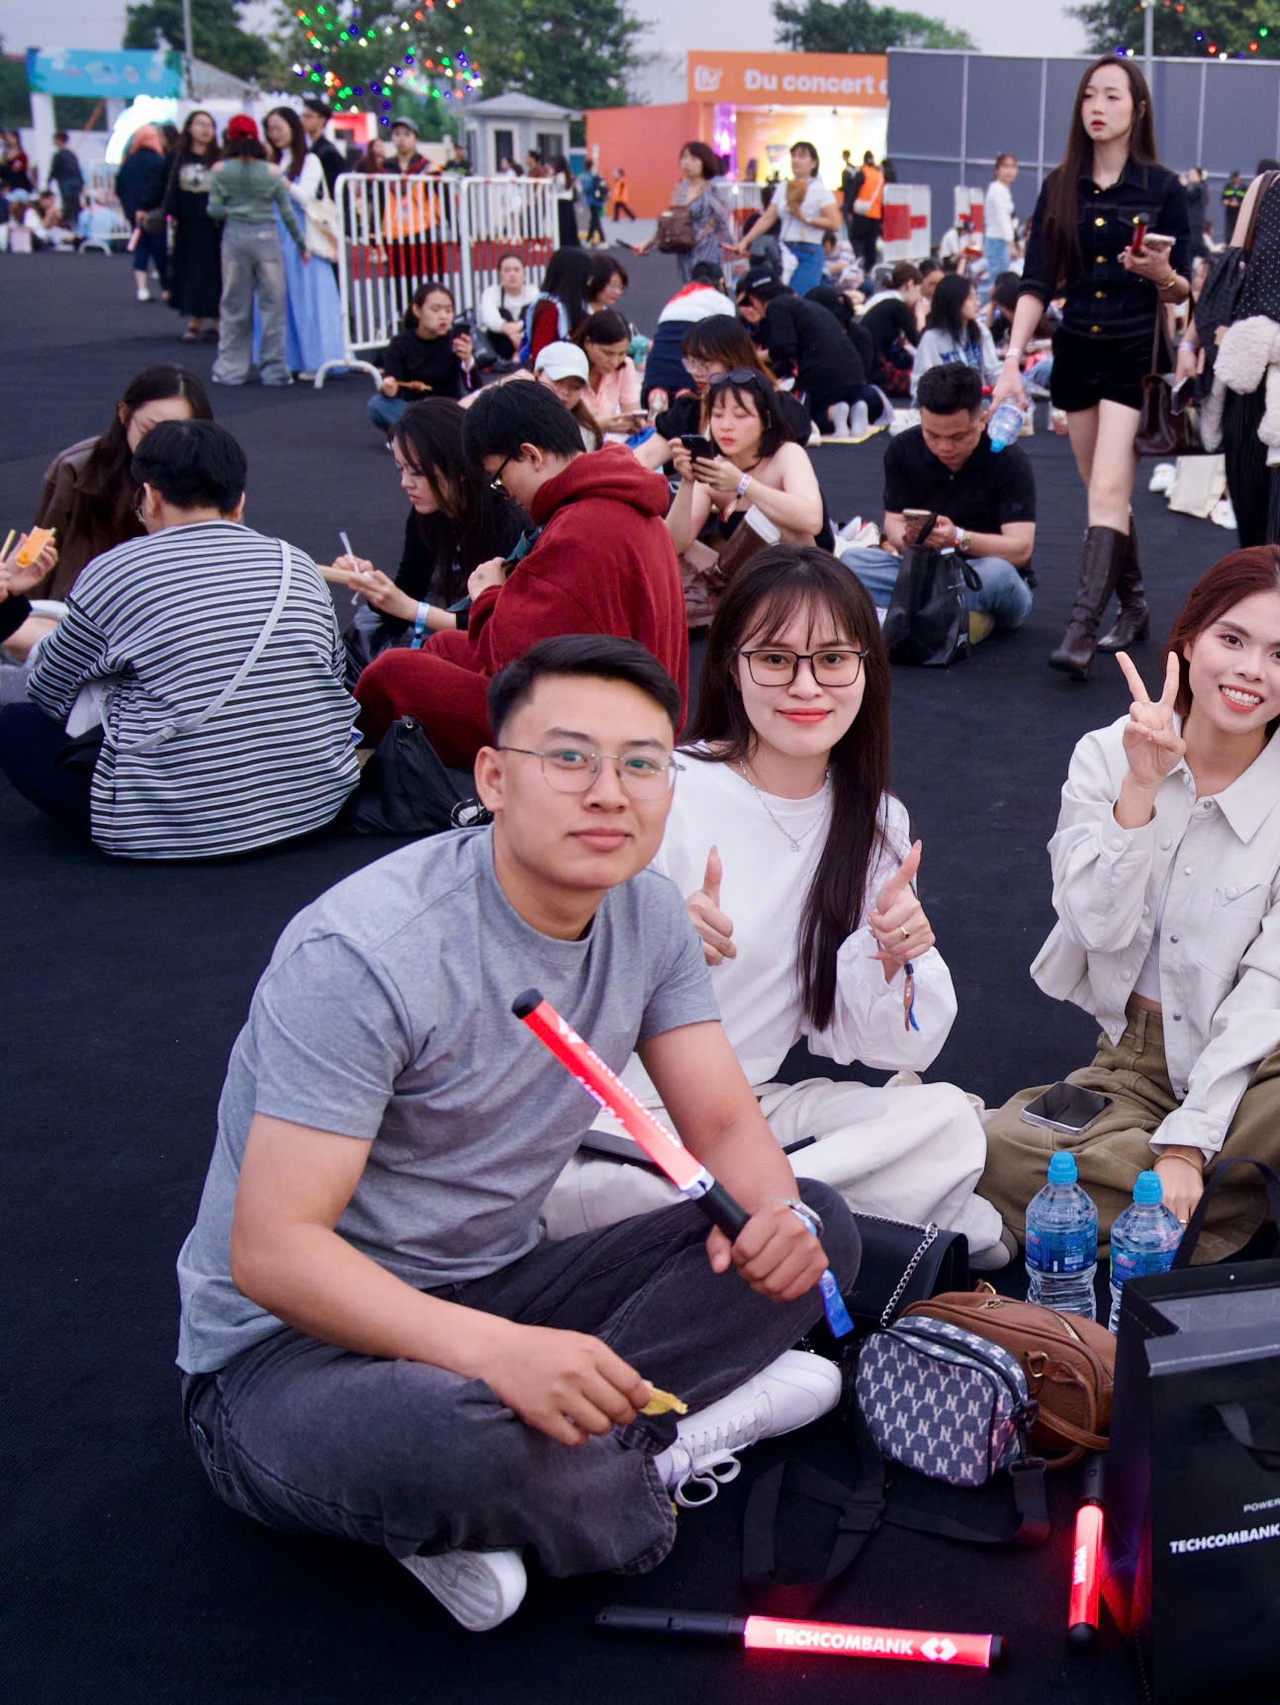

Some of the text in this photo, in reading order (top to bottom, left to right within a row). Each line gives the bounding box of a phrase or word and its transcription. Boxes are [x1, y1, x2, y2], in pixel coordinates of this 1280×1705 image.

[782, 74, 875, 94] concert
[1169, 1522, 1280, 1554] TECHCOMBANK
[775, 1628, 914, 1655] TECHCOMBANK
